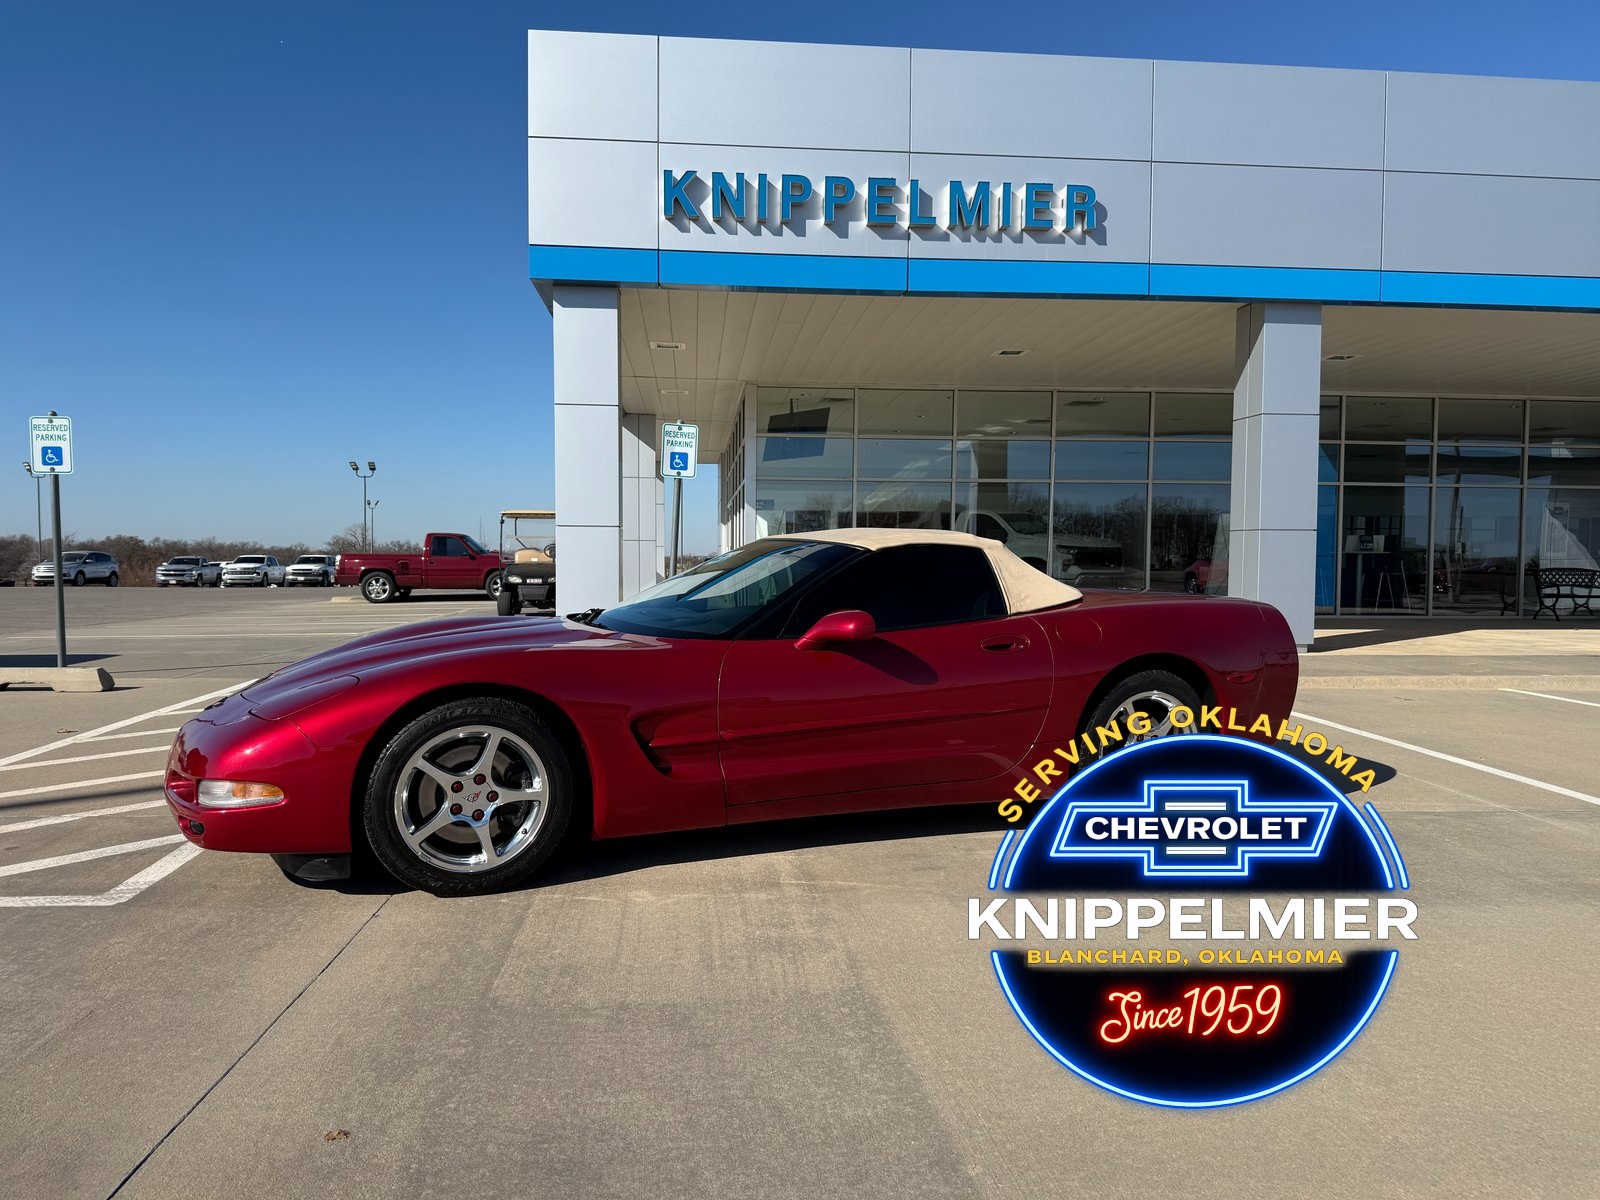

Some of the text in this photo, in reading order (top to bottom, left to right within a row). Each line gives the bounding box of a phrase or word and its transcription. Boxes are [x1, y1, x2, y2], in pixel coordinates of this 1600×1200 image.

[663, 169, 1097, 232] KNIPPELMIER
[35, 433, 67, 441] PARKING
[664, 430, 695, 439] RESERVED
[666, 439, 694, 448] PARKING
